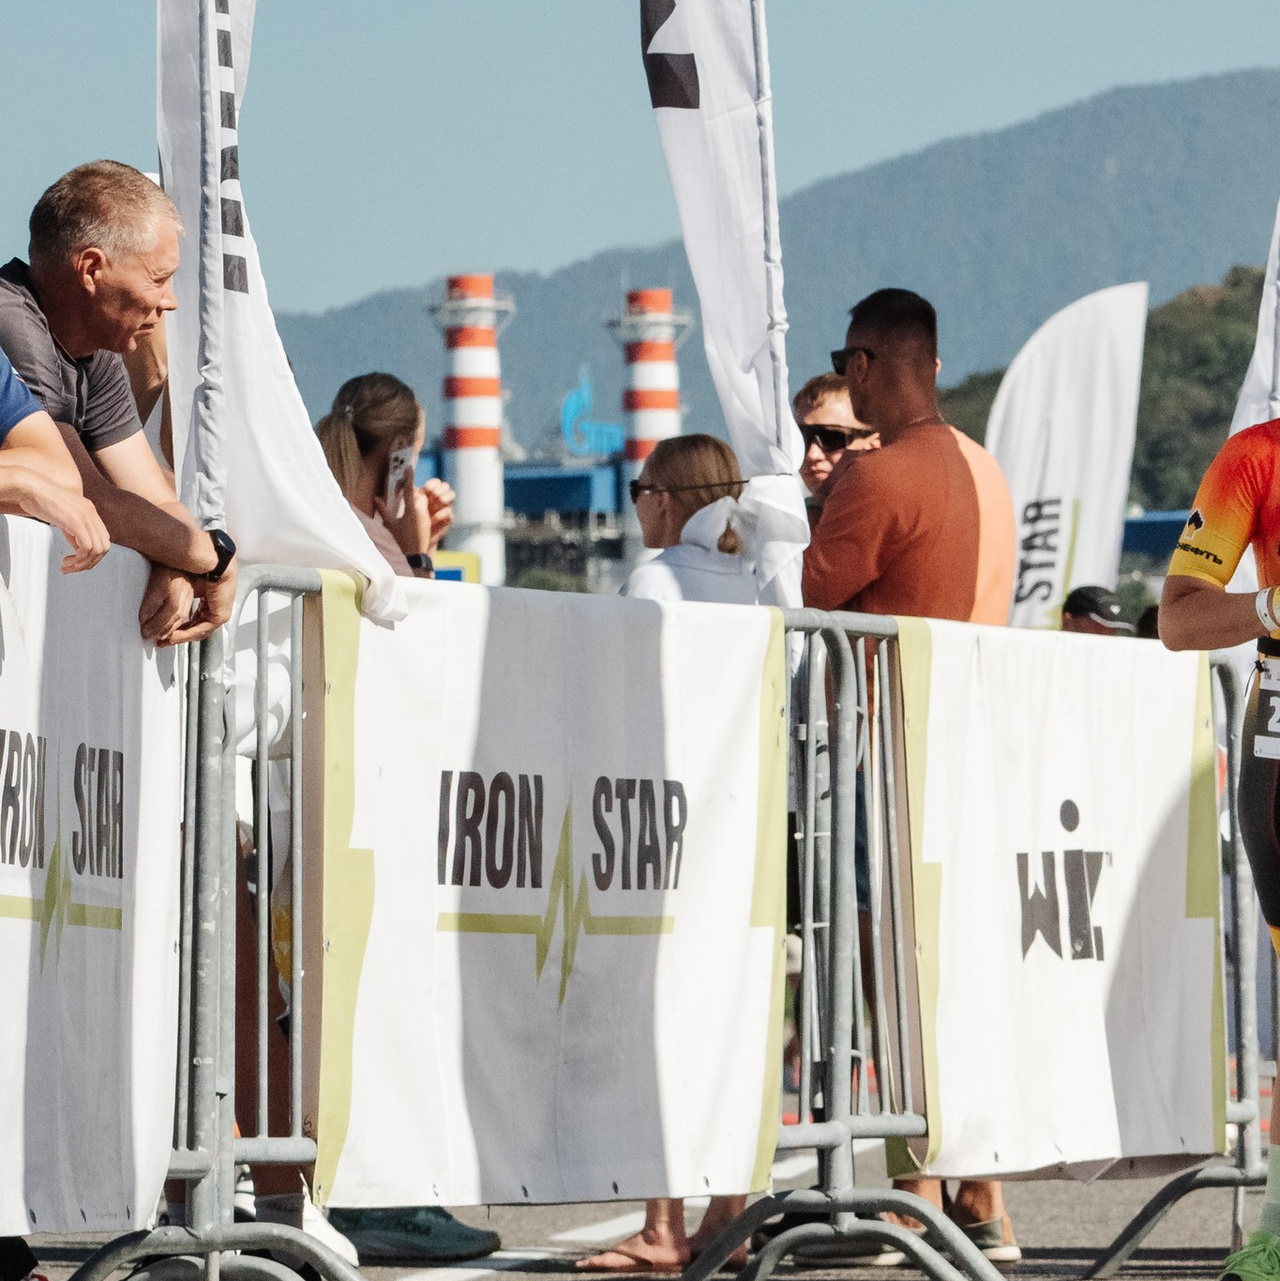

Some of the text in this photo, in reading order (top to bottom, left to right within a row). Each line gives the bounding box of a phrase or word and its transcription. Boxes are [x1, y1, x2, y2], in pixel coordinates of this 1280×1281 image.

[1014, 498, 1062, 603] STAR
[1178, 542, 1223, 565] НЕФТЬ
[0, 729, 124, 879] RON STAR
[437, 770, 688, 892] IRON STAR
